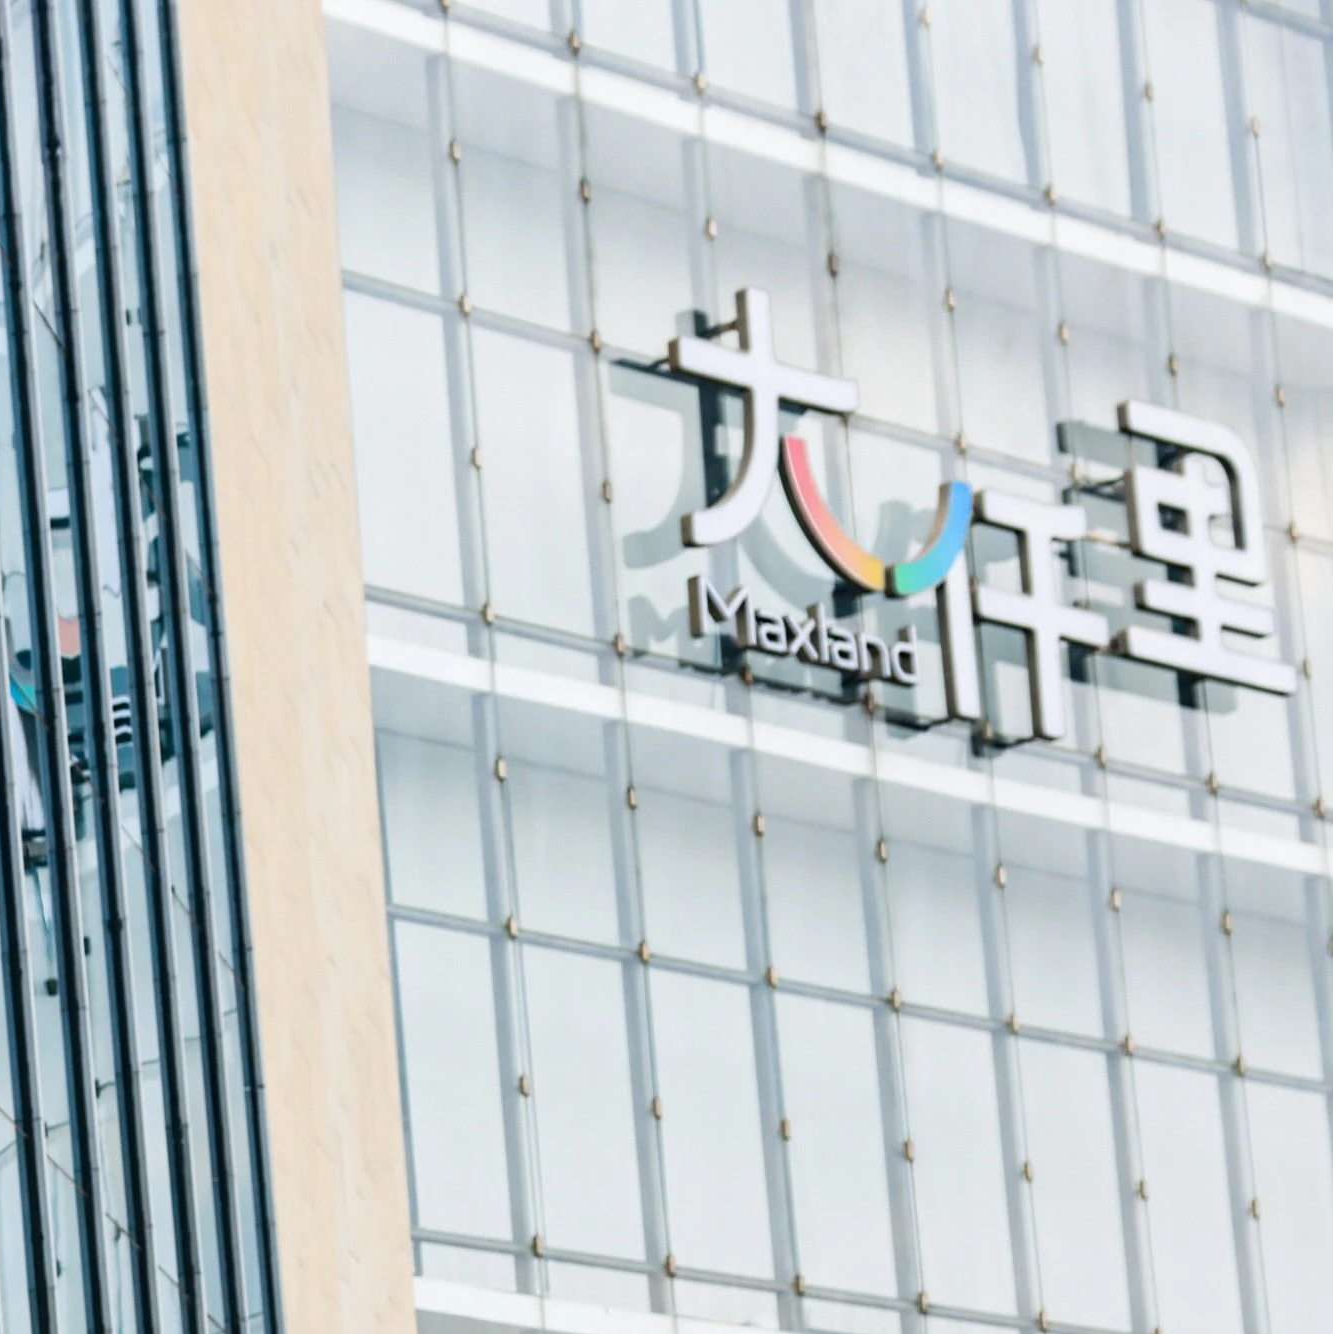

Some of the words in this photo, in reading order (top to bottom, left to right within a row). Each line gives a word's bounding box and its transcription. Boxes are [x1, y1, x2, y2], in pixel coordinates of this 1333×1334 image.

[669, 287, 1298, 741] 大仟里
[688, 576, 921, 687] Maxland
